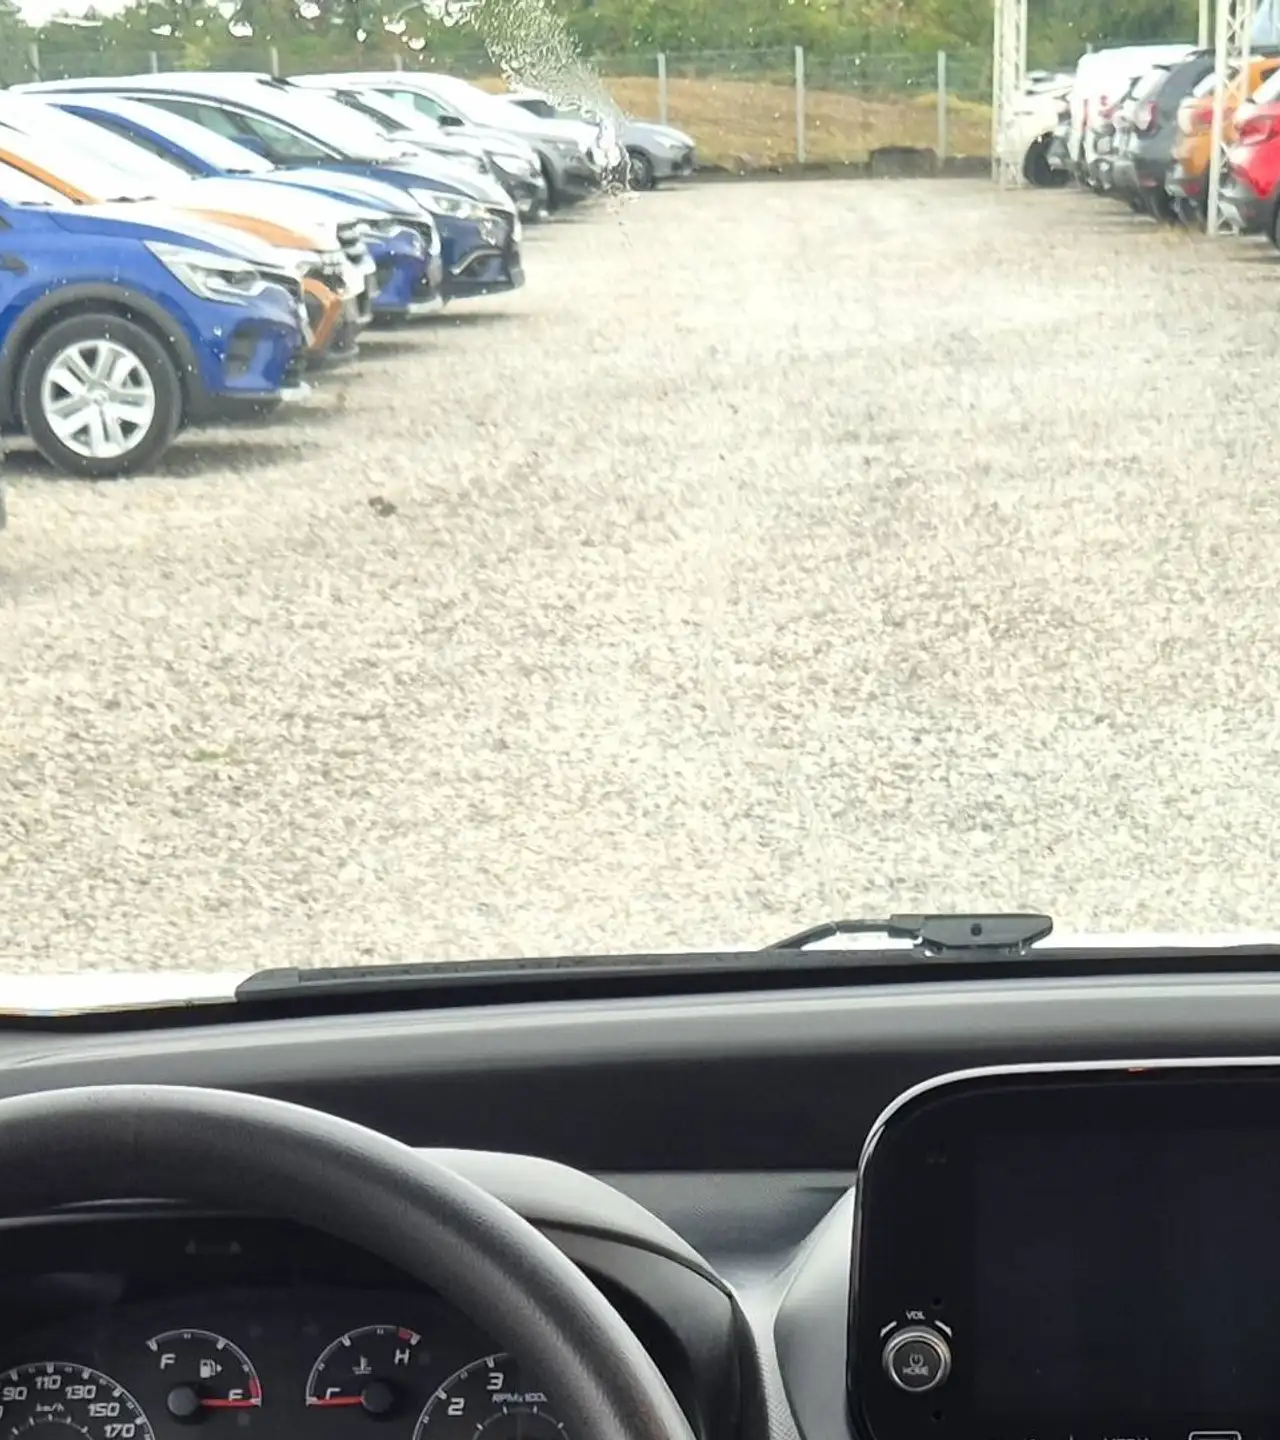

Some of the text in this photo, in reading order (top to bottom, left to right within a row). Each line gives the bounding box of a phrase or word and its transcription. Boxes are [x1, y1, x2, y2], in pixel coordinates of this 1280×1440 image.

[905, 1310, 926, 1320] VOL
[160, 1353, 176, 1369] F
[394, 1349, 410, 1365] H
[35, 1375, 61, 1389] 110
[487, 1372, 504, 1390] 3
[2, 1386, 27, 1401] 90
[65, 1385, 96, 1399] 130
[88, 1402, 120, 1417] 150
[447, 1398, 465, 1415] 2
[104, 1423, 134, 1438] 170
